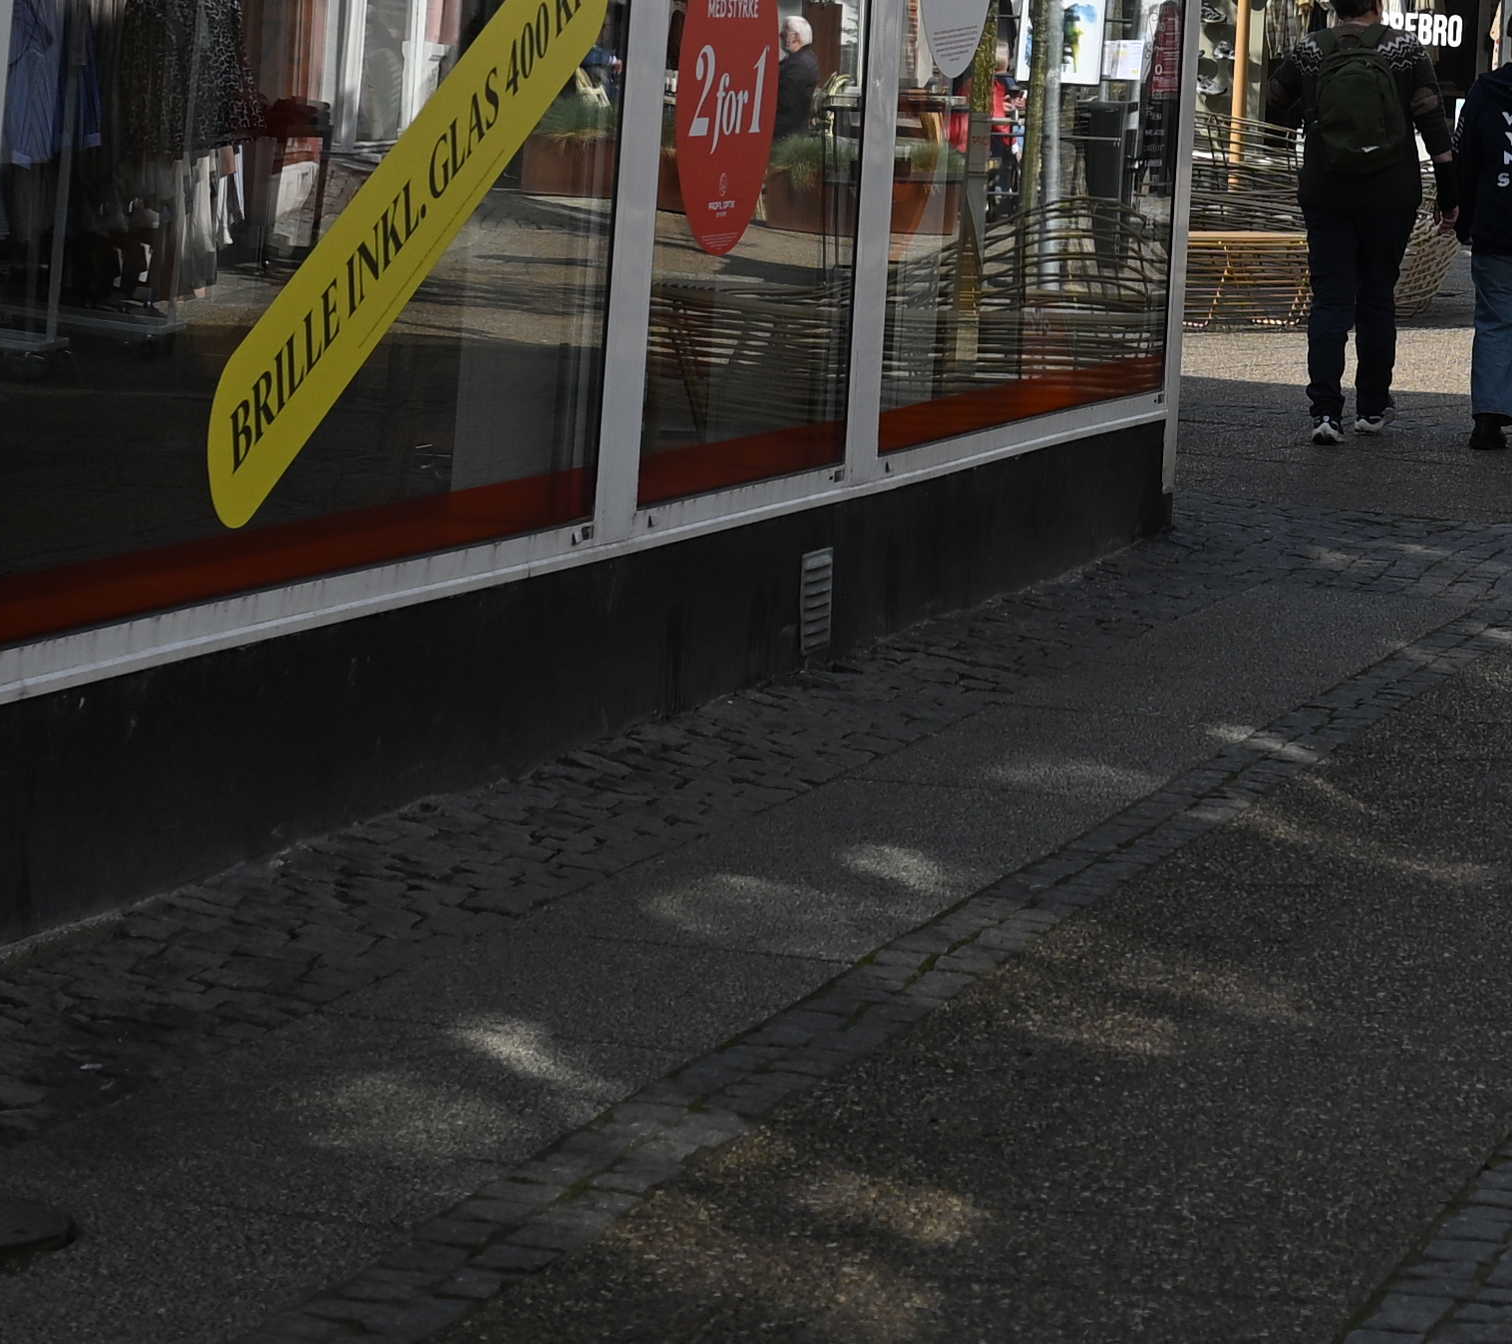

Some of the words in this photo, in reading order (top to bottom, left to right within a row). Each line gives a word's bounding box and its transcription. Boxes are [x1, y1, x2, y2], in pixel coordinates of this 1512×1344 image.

[231, 278, 342, 474] BRILLE
[345, 178, 428, 320] INKL.
[428, 67, 501, 199] GLAS
[504, 0, 553, 97] 400
[688, 44, 716, 137] 2
[710, 72, 749, 154] for
[748, 45, 770, 133] 1
